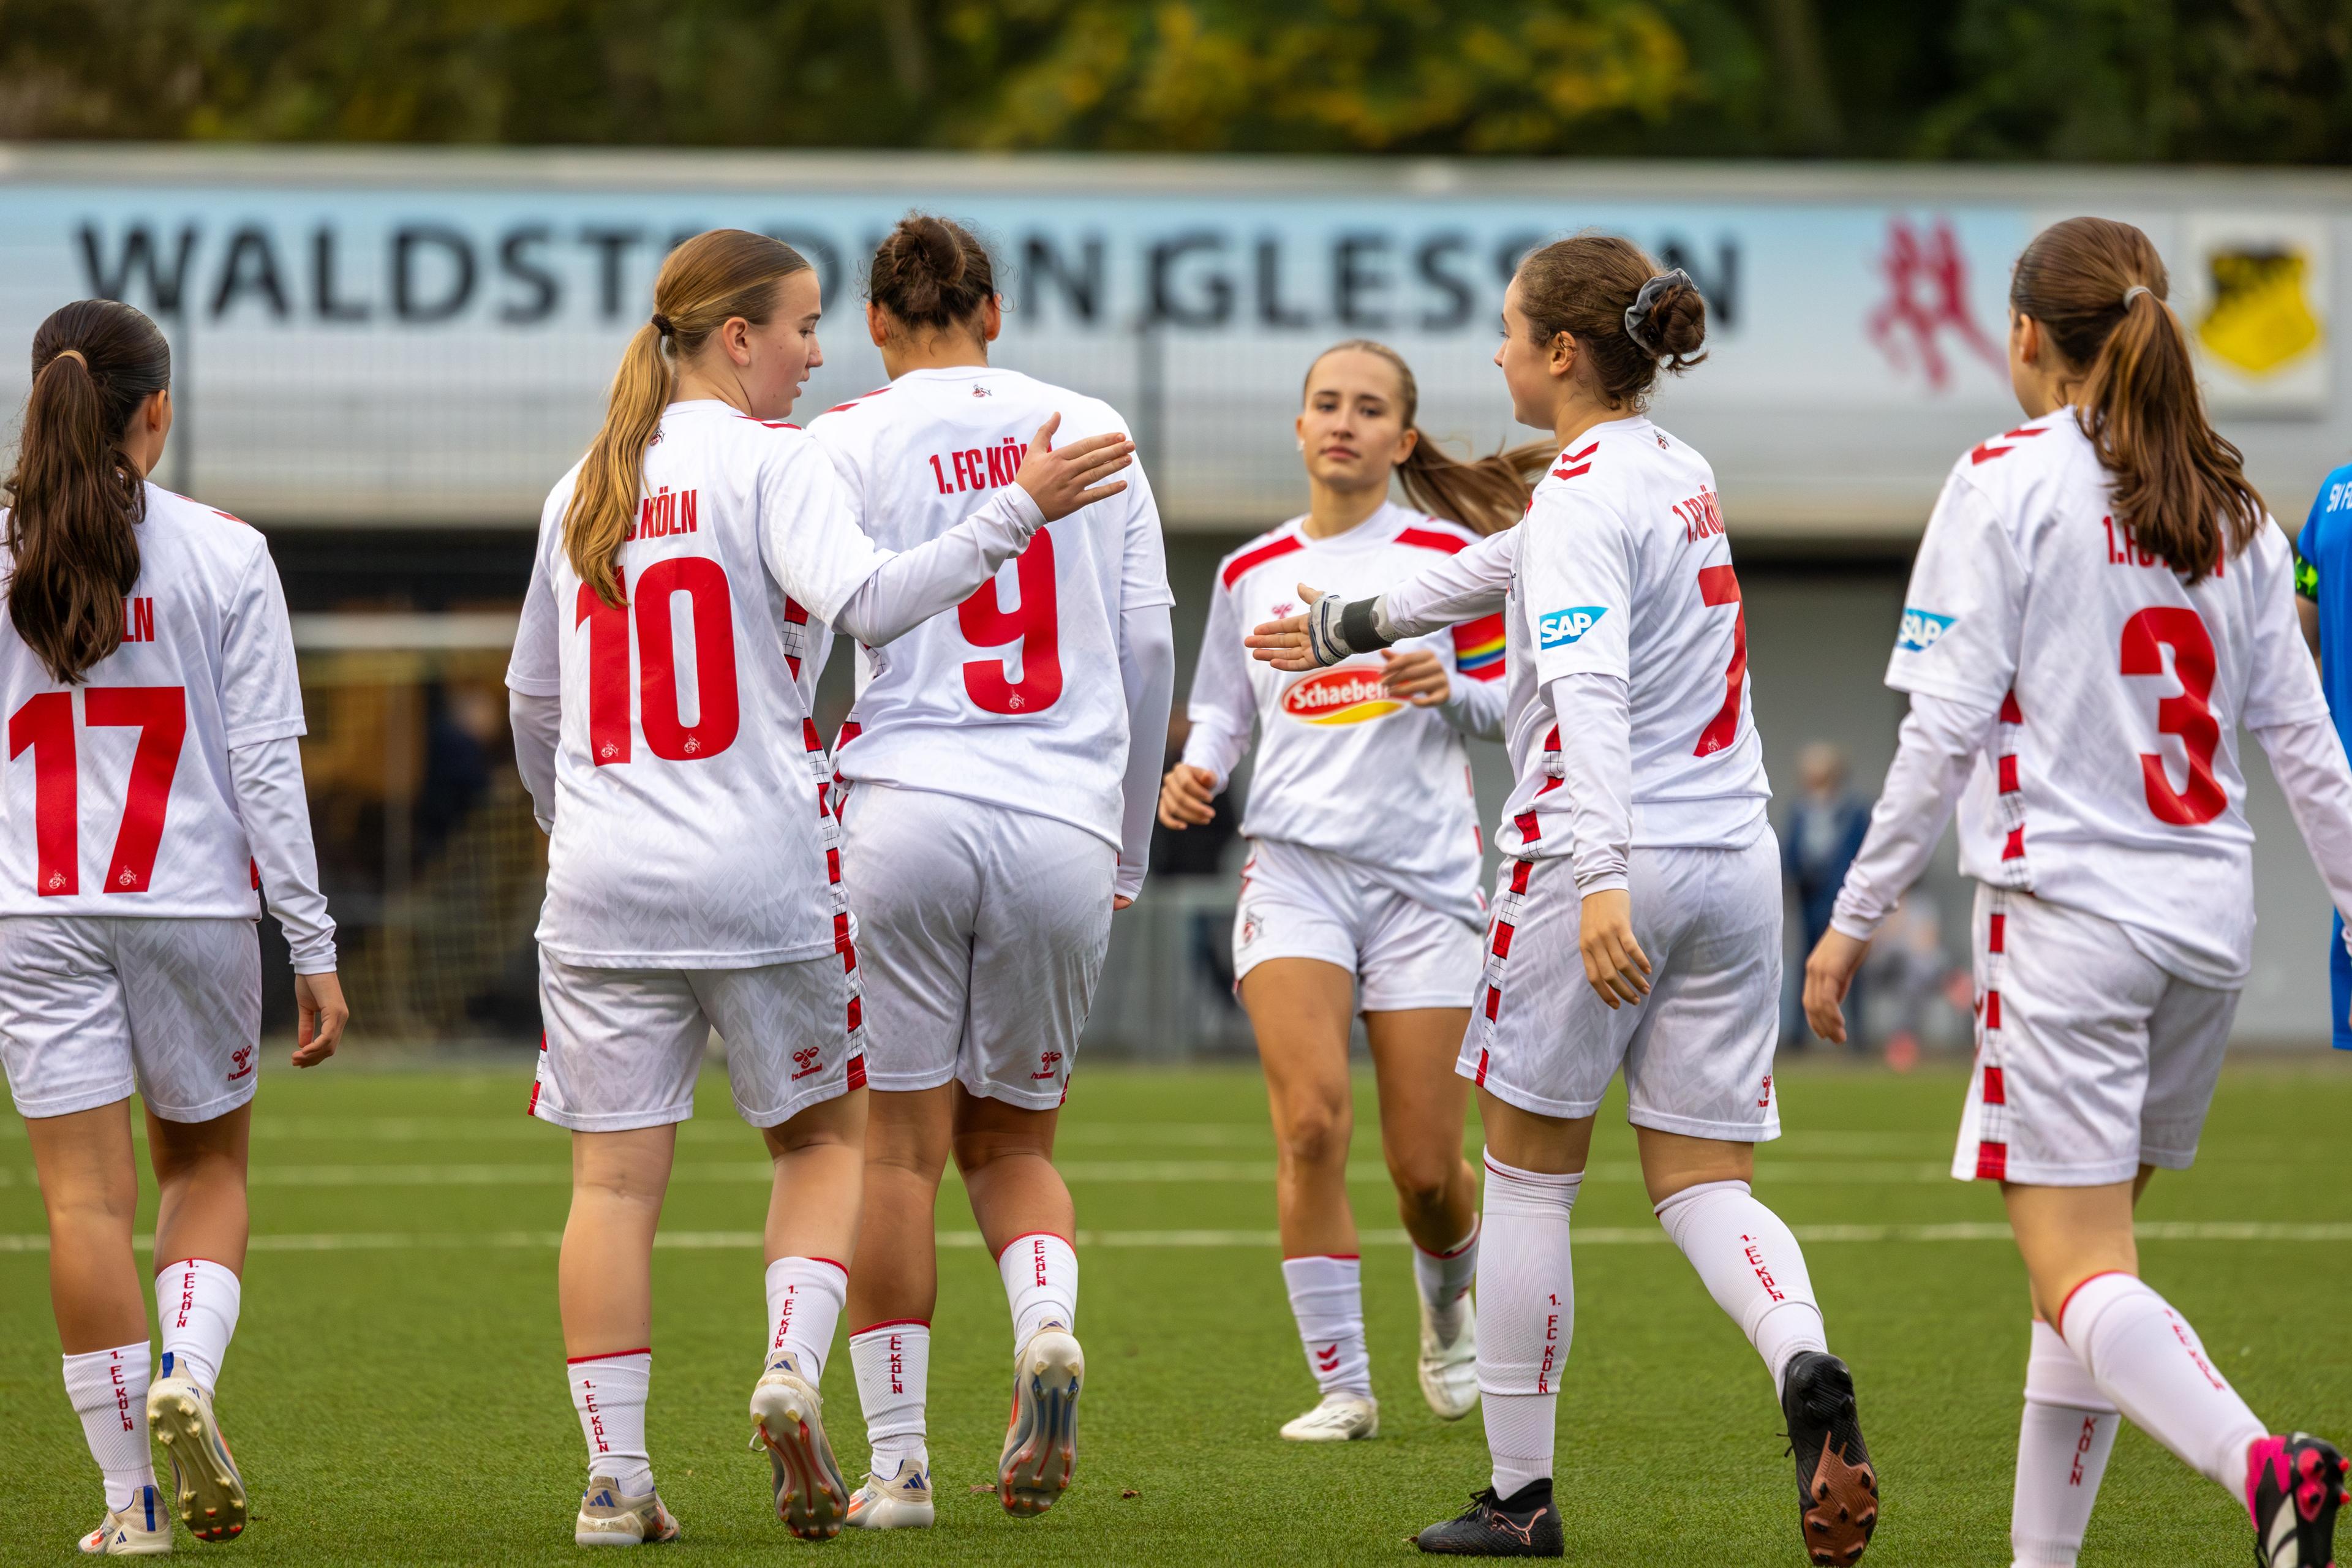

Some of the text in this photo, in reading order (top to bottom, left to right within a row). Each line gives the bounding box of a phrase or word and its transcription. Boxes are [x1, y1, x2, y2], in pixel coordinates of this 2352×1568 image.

[77, 223, 1741, 331] WALDSTDN GLESN
[640, 485, 697, 540] KÖLN
[121, 597, 154, 643] LN
[957, 525, 1063, 715] 9
[1540, 612, 1593, 644] SAP
[1901, 614, 1942, 648] SAP
[575, 556, 740, 767] 10
[1693, 564, 1747, 758] 7
[2120, 605, 2228, 827] 3
[8, 685, 187, 897] 17
[184, 1272, 195, 1289] FC
[176, 1291, 194, 1328] KÖLN
[783, 1298, 794, 1316] FC
[1547, 1314, 1559, 1340] FC
[110, 1365, 124, 1385] FC
[891, 1353, 903, 1394] KÖLN
[1538, 1344, 1556, 1394] KÖLN
[115, 1387, 134, 1431] KÖLN
[586, 1393, 598, 1413] FC
[590, 1415, 609, 1453] KÖLN
